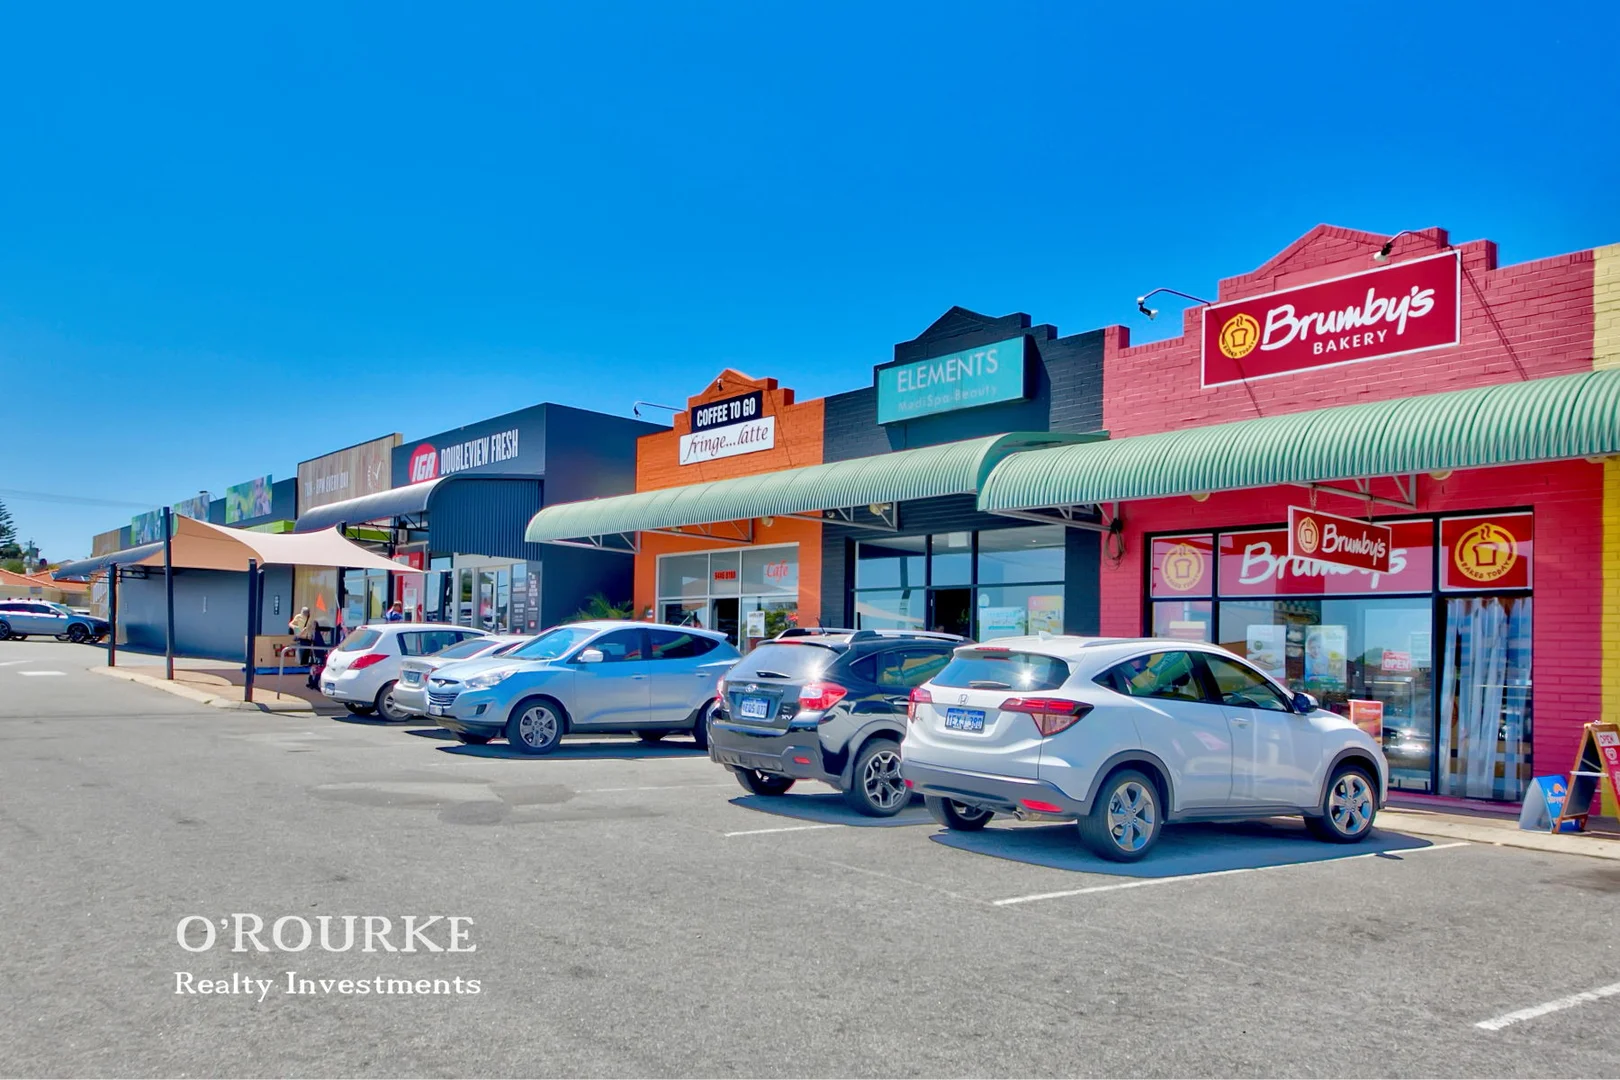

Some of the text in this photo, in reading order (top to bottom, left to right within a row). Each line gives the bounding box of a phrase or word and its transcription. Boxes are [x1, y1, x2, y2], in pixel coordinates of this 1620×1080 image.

[1260, 286, 1434, 351] Brumby's
[1313, 329, 1387, 355] BAKERY
[897, 349, 999, 393] ELEMENTS
[696, 396, 756, 427] COFFEE TO GO
[411, 451, 437, 482] IGA
[440, 428, 519, 475] DOUBLEVIEW FRESH
[1321, 523, 1386, 566] Brumby's
[1461, 561, 1510, 579] BAKED TODAY
[1384, 658, 1410, 669] OPEN
